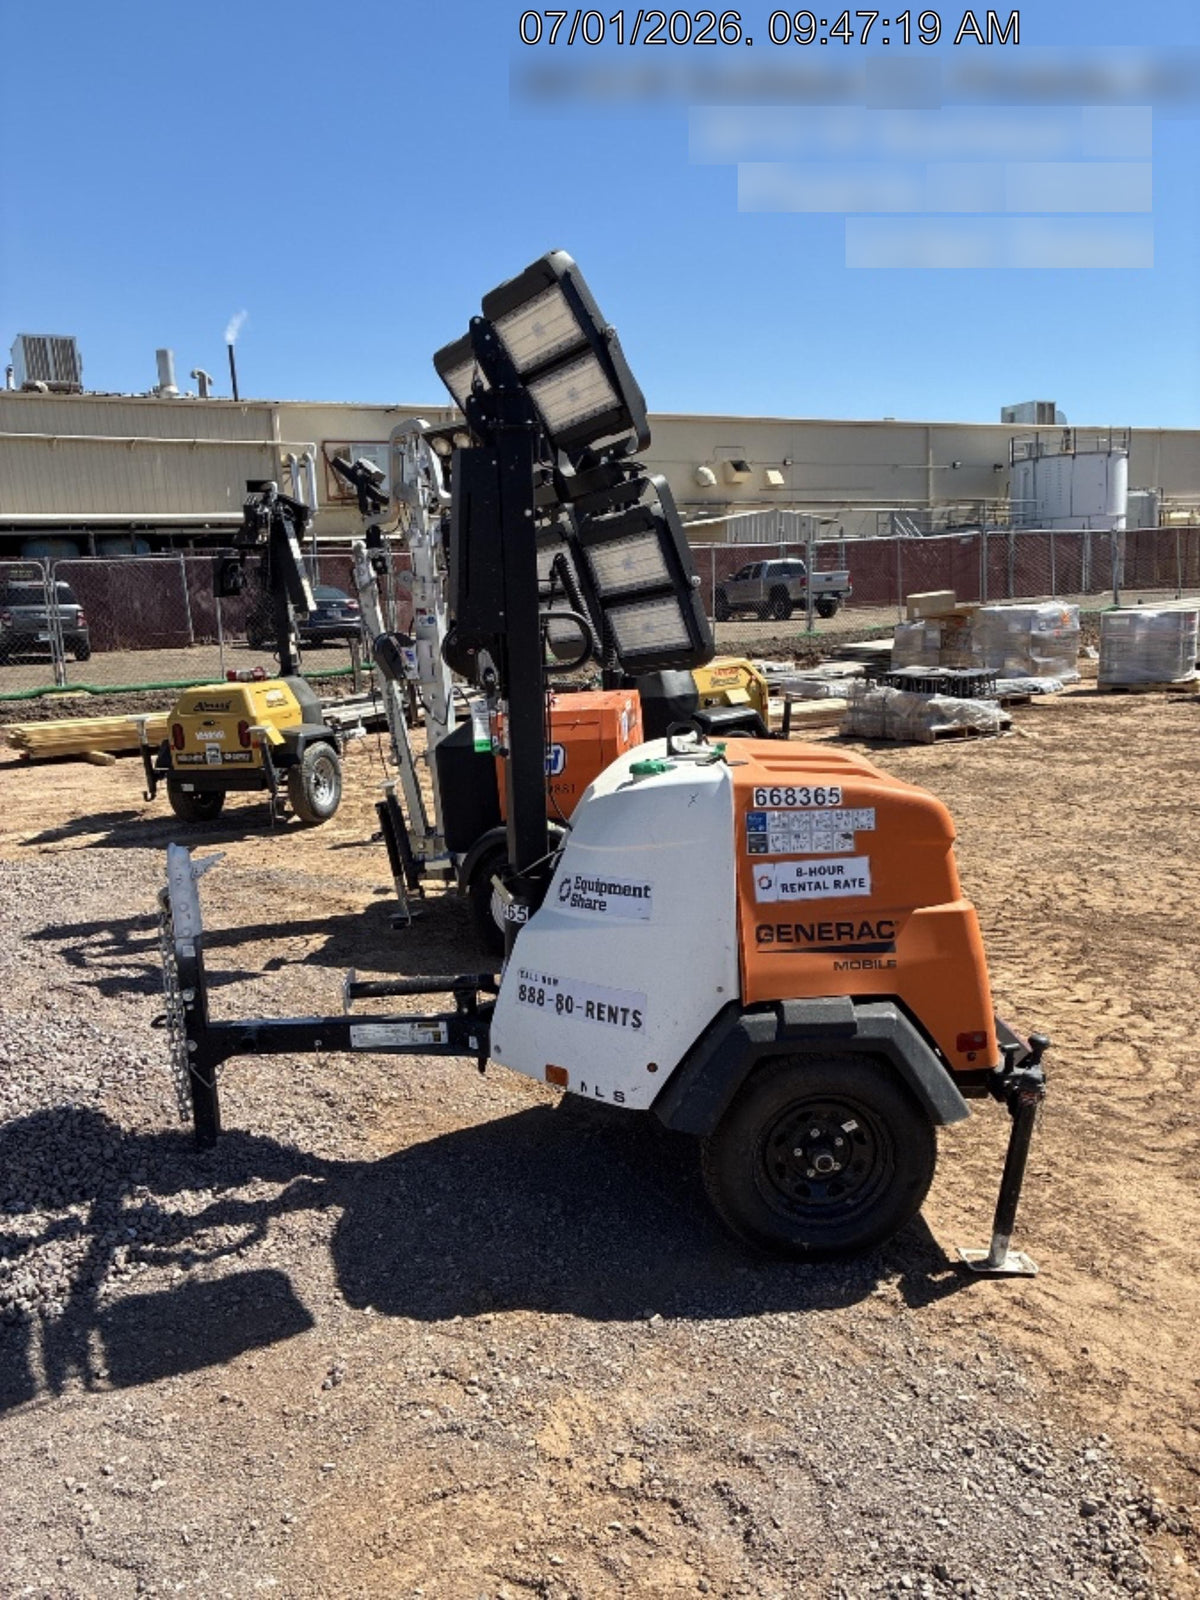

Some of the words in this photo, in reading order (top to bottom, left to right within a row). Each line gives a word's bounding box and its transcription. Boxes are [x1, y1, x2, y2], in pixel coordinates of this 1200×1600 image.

[755, 787, 841, 807] 668365
[796, 865, 845, 877] 8-HOUR
[573, 876, 651, 899] Equipment
[781, 881, 829, 893] RENTAL
[833, 878, 867, 889] RATE
[570, 893, 607, 911] Share
[755, 921, 896, 943] GENERAC
[833, 959, 897, 971] MOBILE
[518, 984, 643, 1029] 888-80-RENTS
